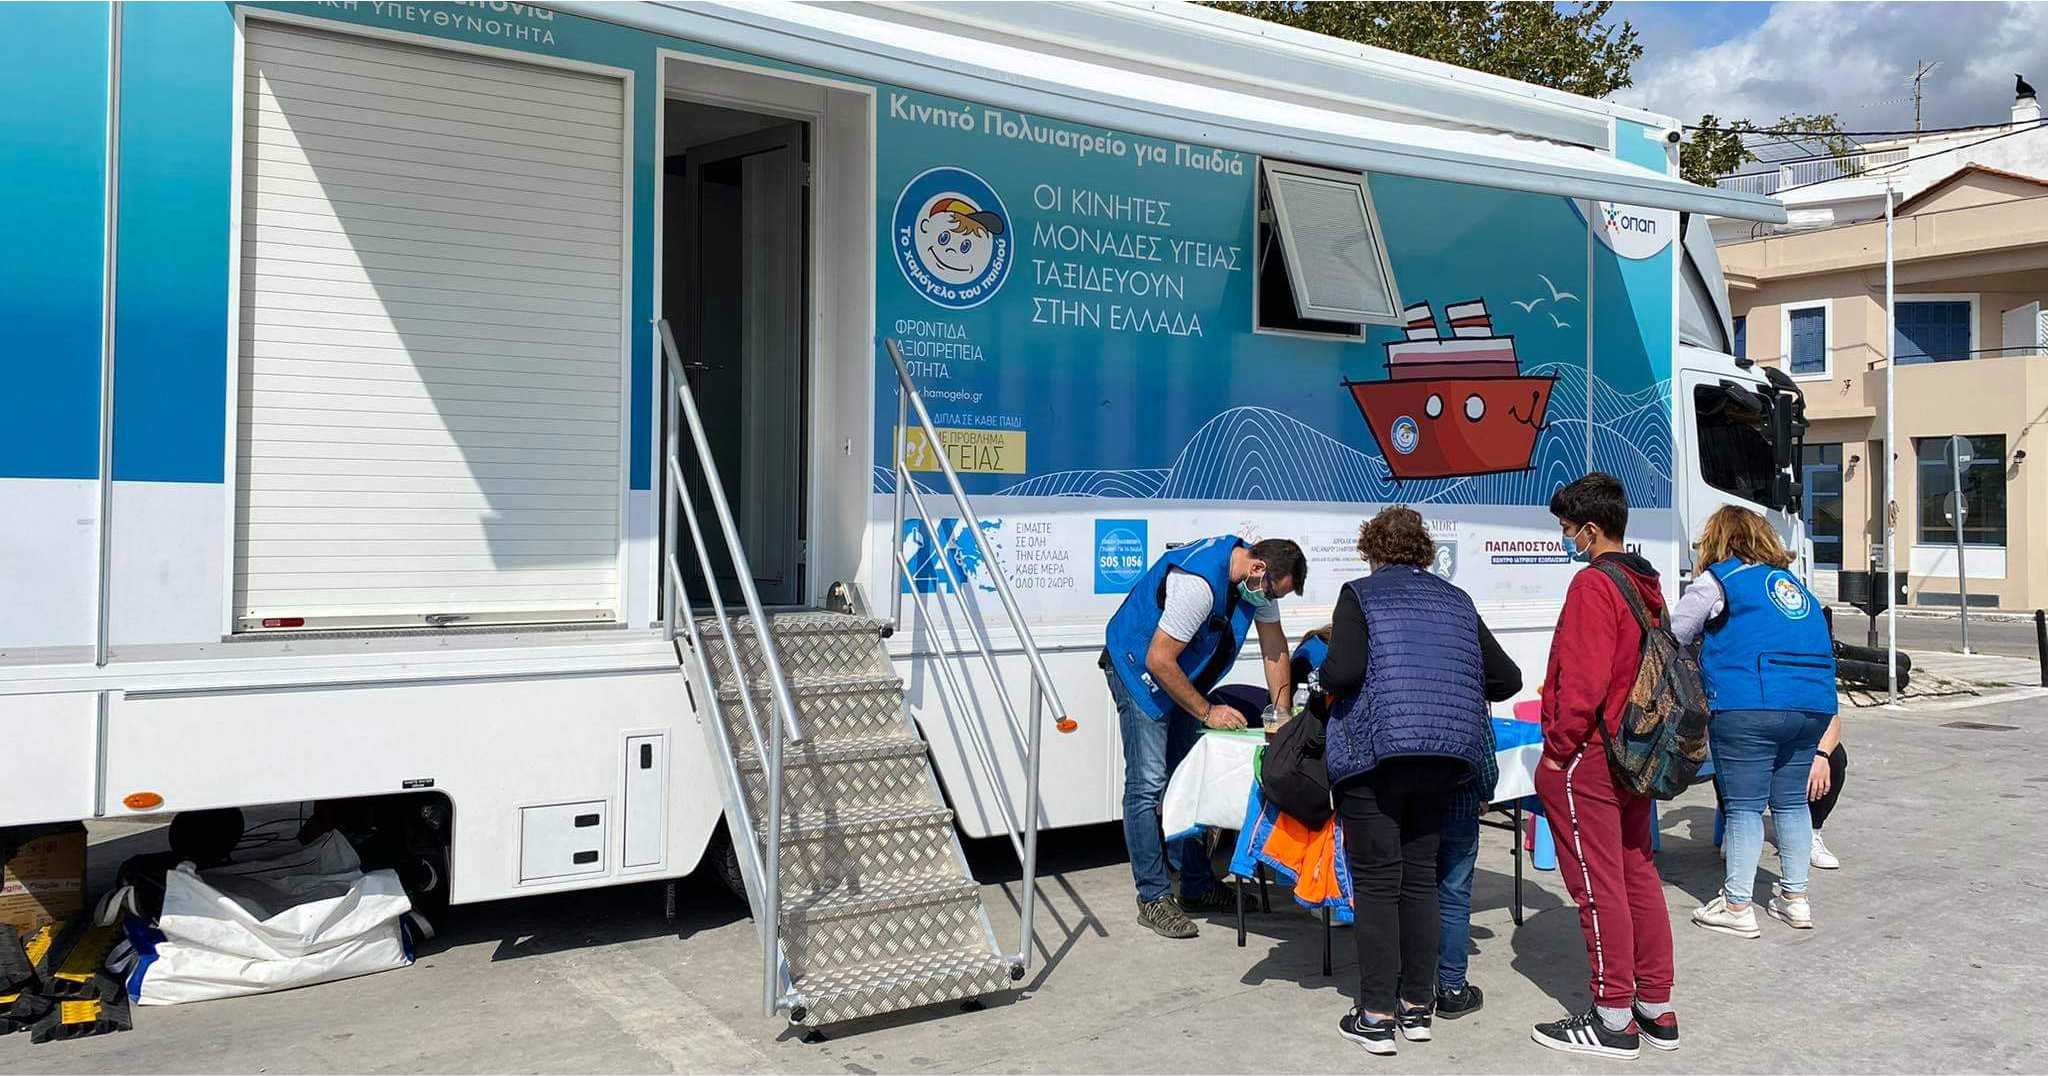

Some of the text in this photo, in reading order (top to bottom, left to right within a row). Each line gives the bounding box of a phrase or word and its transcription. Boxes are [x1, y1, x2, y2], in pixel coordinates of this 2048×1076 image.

[372, 1, 556, 46] ΥΠΕΥΘΥΝΟΤΗΤΑ
[889, 93, 1244, 176] Κινητό Πολυιατρείο για Παιδιά
[1033, 183, 1172, 227] ΟΙ ΚΙΝΗΤΕΣ
[1032, 222, 1243, 272] ΜΟΝΑΔΕΣ ΥΓΕΙΑΣ
[904, 250, 956, 300] χαμόγελο
[958, 285, 982, 300] του
[980, 238, 1007, 290] παιδιού
[1032, 259, 1185, 301] ΤΑΞΙΔΕΥΟΥΝ
[1032, 297, 1204, 337] ΣΤΗΝ ΕΛΛΑΔΑ
[894, 385, 983, 403] .hamogelo.gr
[934, 412, 961, 425] ΔΙΠΛΑ
[962, 413, 974, 425] ΣΕ
[975, 415, 999, 427] ΚΑΘΕ
[950, 432, 1005, 445] ΠΡΟΒΛΗΜΑ
[938, 445, 1005, 471] ΓΕΙΑΣ
[1016, 522, 1052, 534] ΕΙΜΑΣΤΕ
[1016, 536, 1026, 548] ΣΕ
[1016, 550, 1070, 561] ΤΗΝ ΕΛΛΑΔΑ
[1100, 555, 1119, 569] SOS
[1016, 563, 1065, 575] ΚΑΘΕ ΜΕΡΑ
